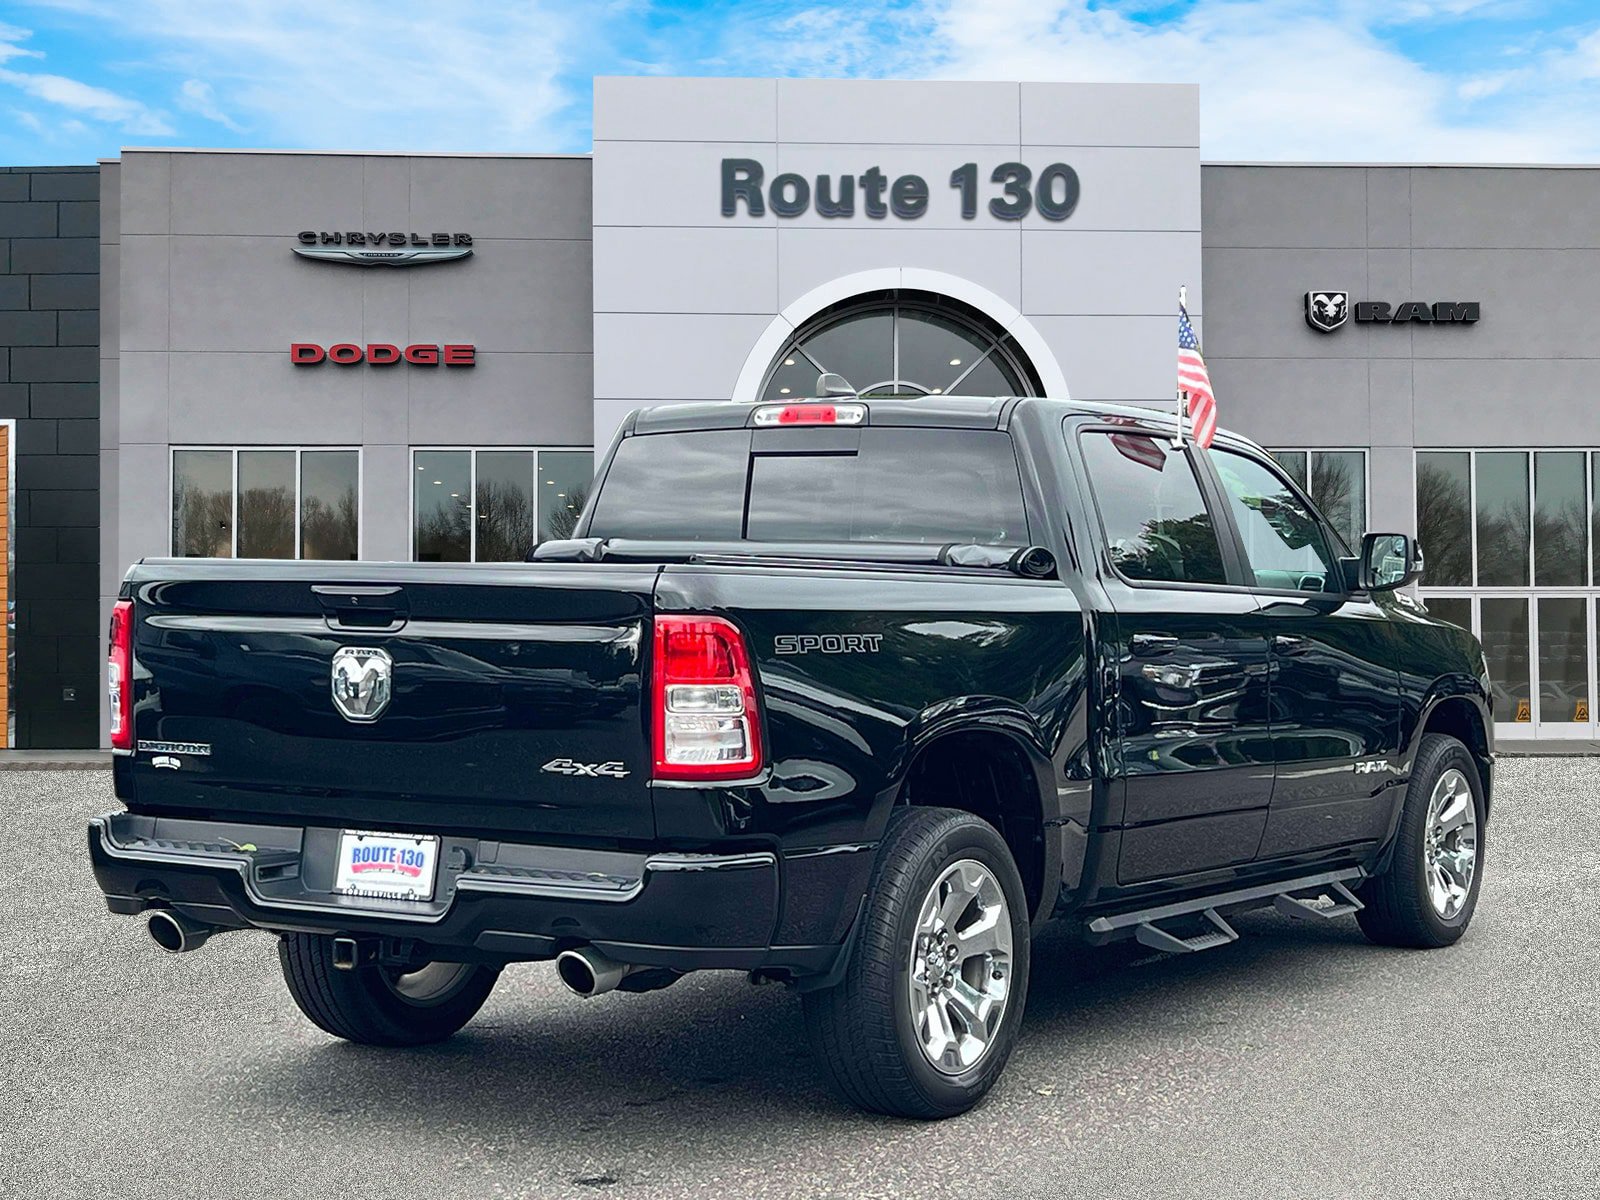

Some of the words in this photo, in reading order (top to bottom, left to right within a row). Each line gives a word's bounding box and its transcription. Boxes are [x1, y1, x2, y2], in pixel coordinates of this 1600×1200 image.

[721, 158, 929, 219] Route
[949, 162, 1080, 221] 130
[298, 231, 473, 246] CHRYSLER
[1355, 302, 1480, 324] RAM
[291, 343, 476, 366] DODGE
[774, 634, 883, 654] SPORT
[352, 847, 396, 863] ROUTE
[399, 849, 425, 868] 130
